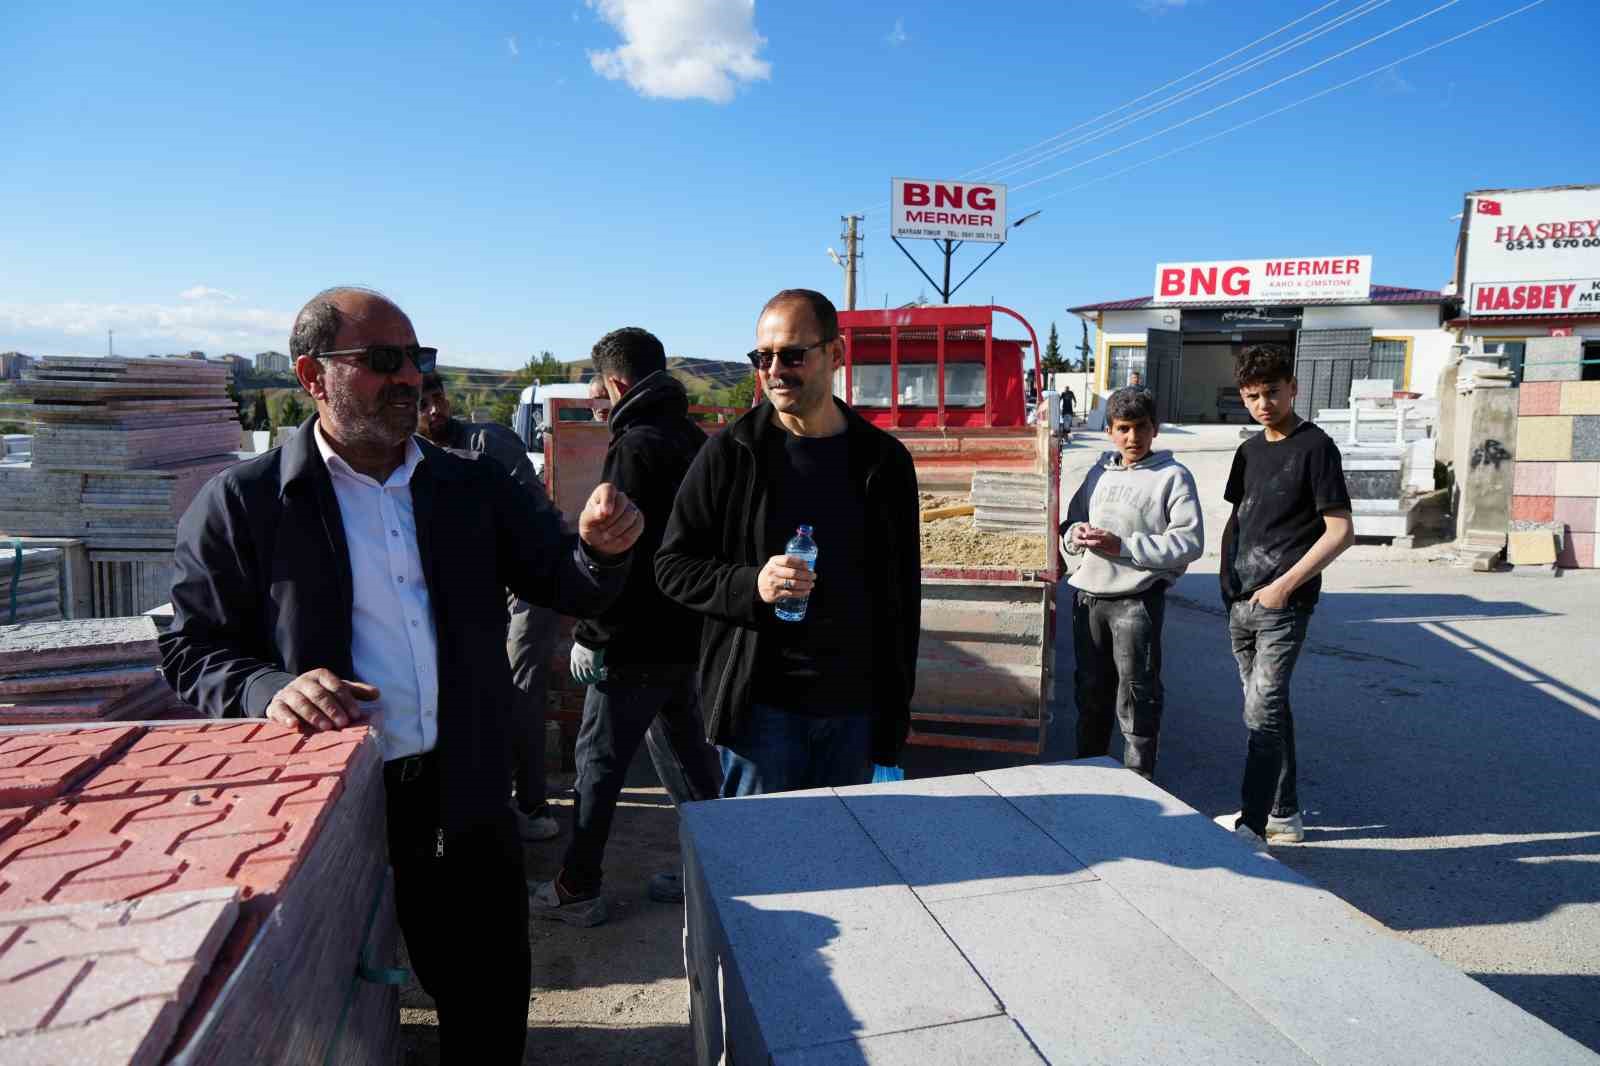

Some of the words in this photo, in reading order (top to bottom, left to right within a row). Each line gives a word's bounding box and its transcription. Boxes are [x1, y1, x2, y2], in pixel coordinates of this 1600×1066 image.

[904, 183, 996, 210] BNG
[906, 211, 993, 226] MERMER
[1495, 221, 1600, 243] HASBEY
[1505, 241, 1545, 251] 0543
[1553, 239, 1579, 248] 670
[1160, 267, 1250, 296] BNG
[1265, 259, 1360, 276] MERMER
[1476, 284, 1576, 310] HASBEY
